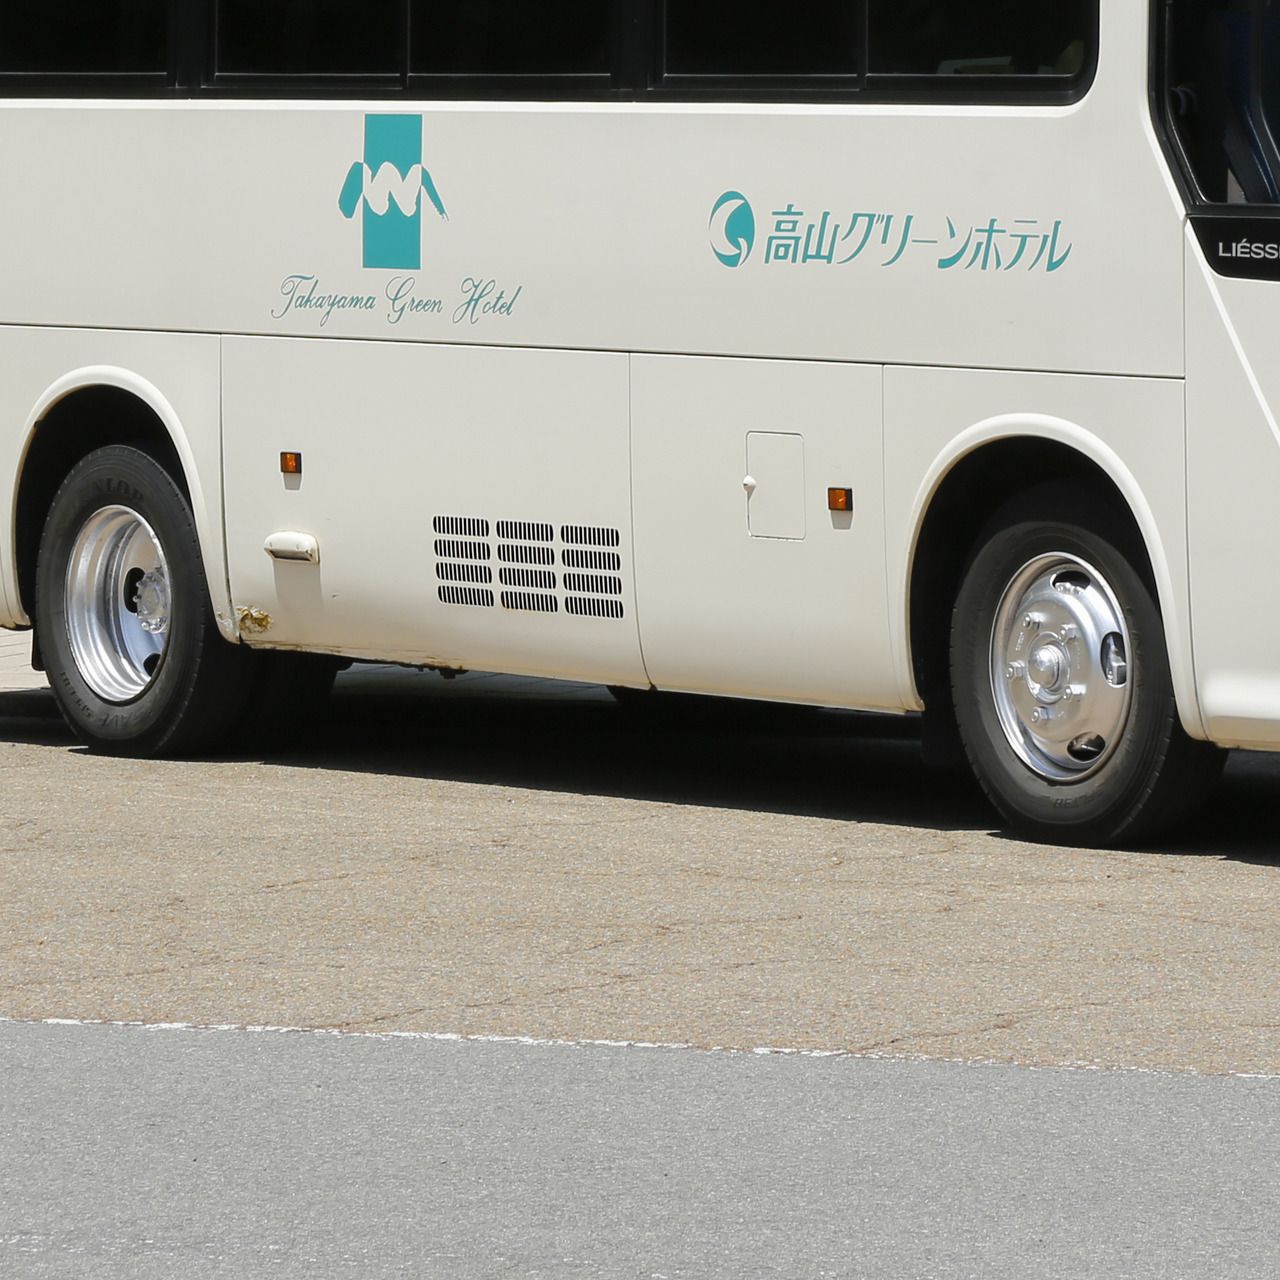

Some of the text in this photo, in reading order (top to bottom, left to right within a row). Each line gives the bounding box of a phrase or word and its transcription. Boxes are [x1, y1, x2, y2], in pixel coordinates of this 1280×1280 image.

[764, 204, 1073, 272] 高山グリーンホテル
[271, 274, 523, 327] Takayama Green Hotel
